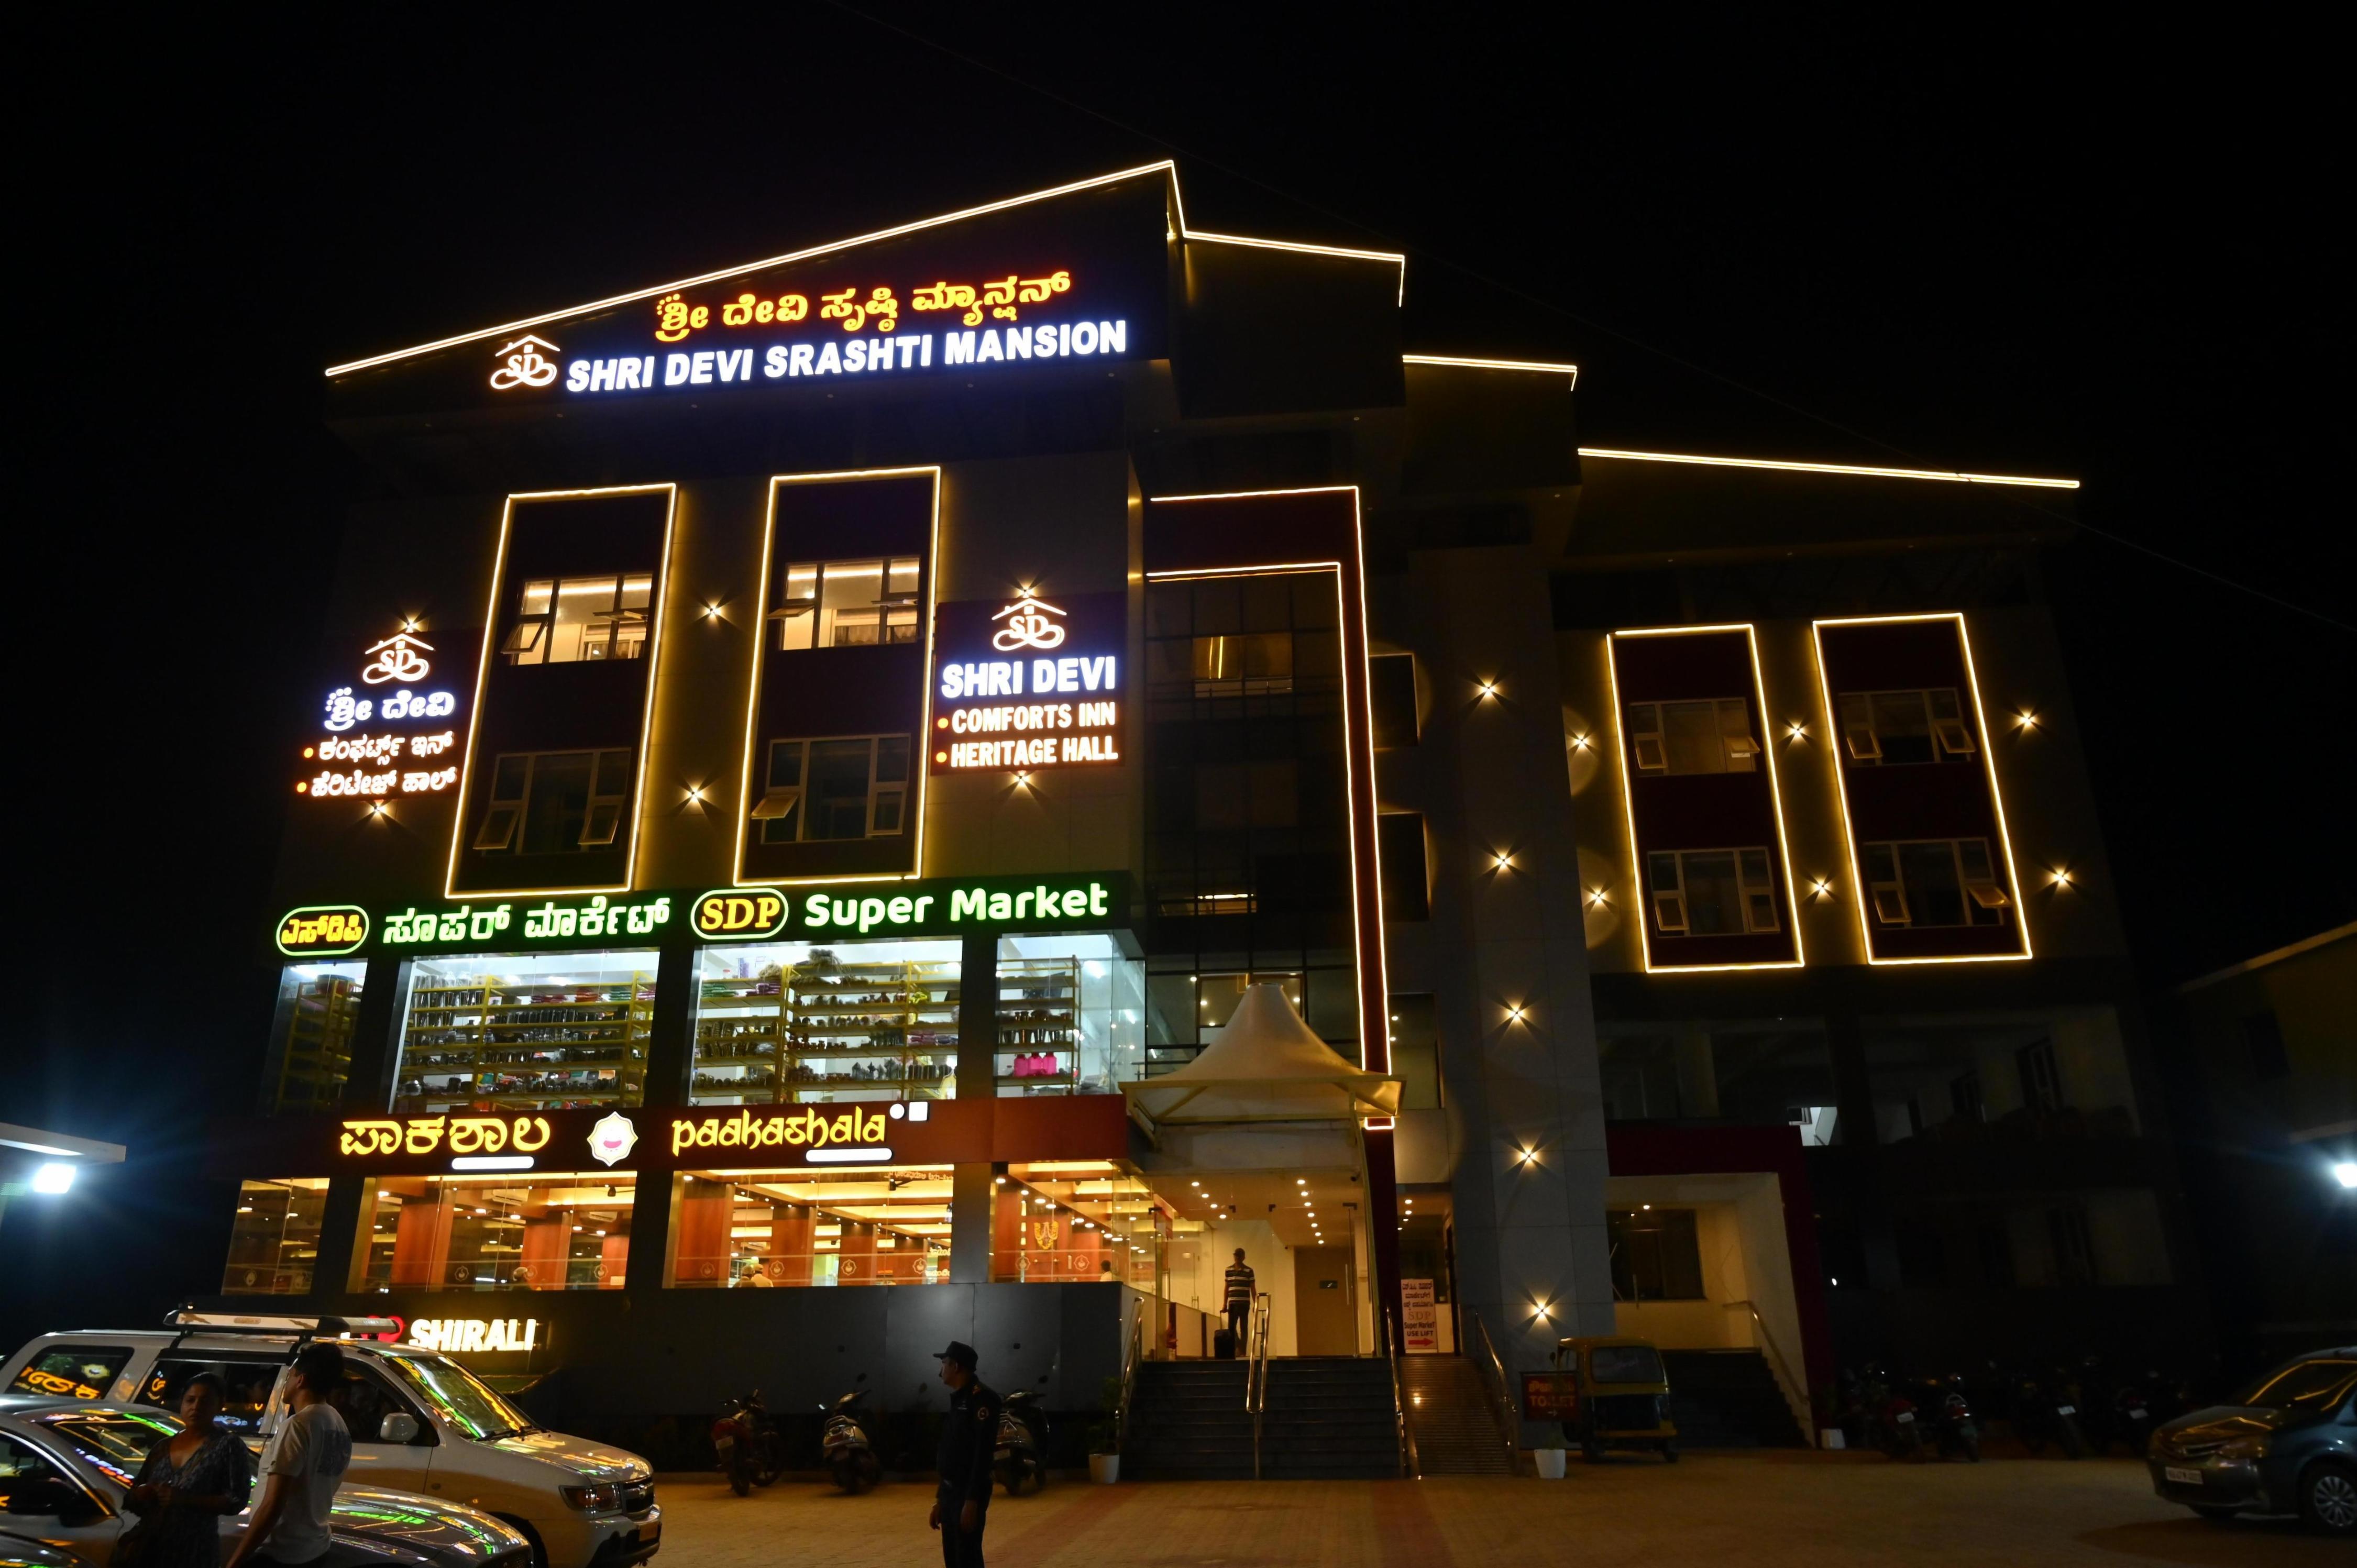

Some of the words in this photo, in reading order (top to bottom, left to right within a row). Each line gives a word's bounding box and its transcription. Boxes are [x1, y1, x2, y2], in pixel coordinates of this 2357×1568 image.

[655, 294, 709, 341] ಶ್ರೀ
[723, 294, 808, 326] ದೇವಿ
[566, 356, 655, 392] SHRI
[664, 349, 753, 385] DEVI
[764, 334, 932, 378] SRASHTI
[944, 320, 1126, 365] MANSION
[941, 661, 1023, 698] SHRI
[1032, 656, 1116, 693] DEVI
[324, 687, 372, 731] ಶ್ರೀ
[381, 690, 455, 719] ದೇವಿ
[952, 703, 1072, 734] COMFORTS
[1078, 701, 1116, 727] INN
[411, 731, 453, 758] ಇನ್
[951, 738, 1057, 767] HERITAGE
[1062, 735, 1118, 762] HALL
[311, 769, 397, 797] ಹೆರಿಟೇಜ್
[402, 766, 456, 792] ಹಾಲ್
[383, 904, 511, 943] ಸೂಪರ್
[524, 896, 670, 937] ಮಾರ್ಕೆಟ್
[701, 897, 780, 930] SDP
[805, 894, 934, 933] Super
[950, 883, 1108, 921] Market
[340, 1116, 550, 1155] ಪಾಕಶಾಲ
[672, 1106, 886, 1156] paakashala
[409, 1319, 536, 1351] SHIRALI
[1404, 1322, 1418, 1330] Super
[1408, 1311, 1430, 1320] SDP
